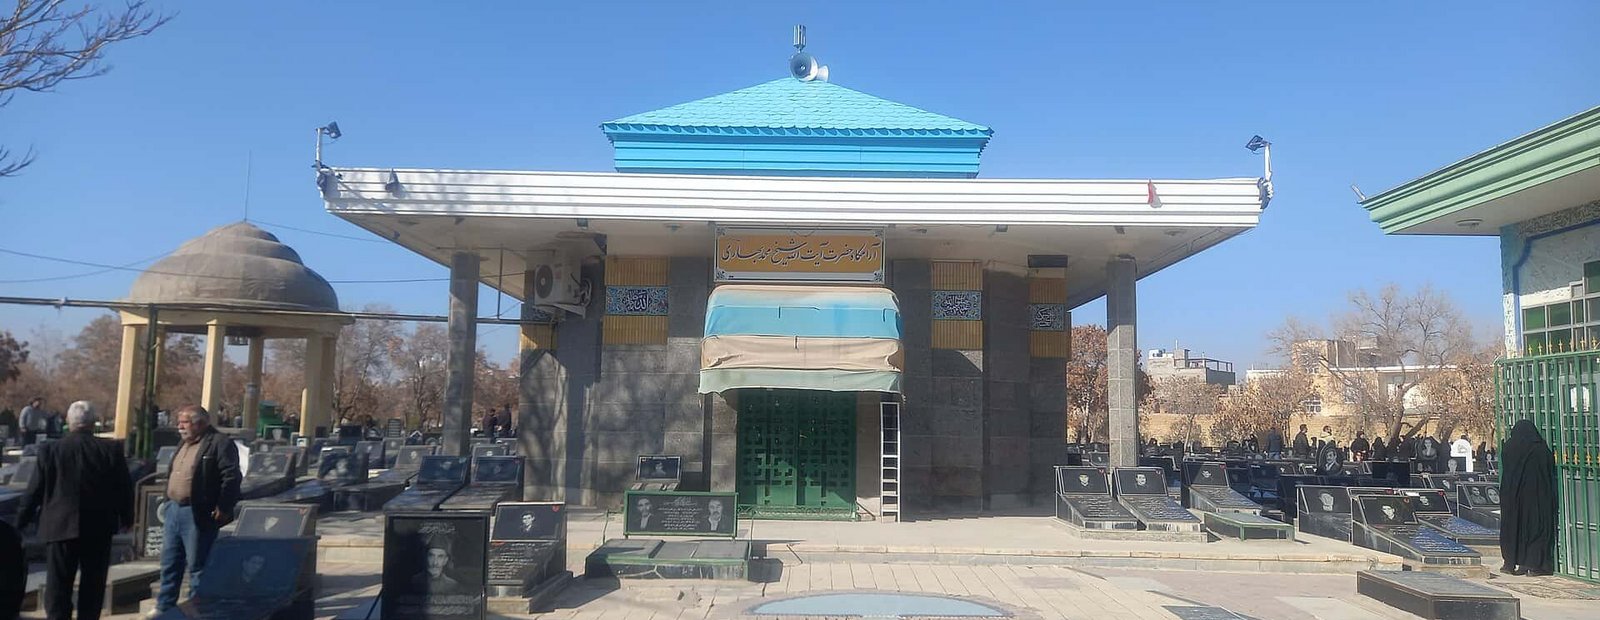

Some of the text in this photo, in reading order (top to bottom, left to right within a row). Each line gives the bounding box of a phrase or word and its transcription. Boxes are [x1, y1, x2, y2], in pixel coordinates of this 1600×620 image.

[771, 238, 807, 265] شیخ
[801, 241, 829, 265] آیت
[823, 244, 853, 263] حضرت
[850, 241, 881, 262] آرامگاه
